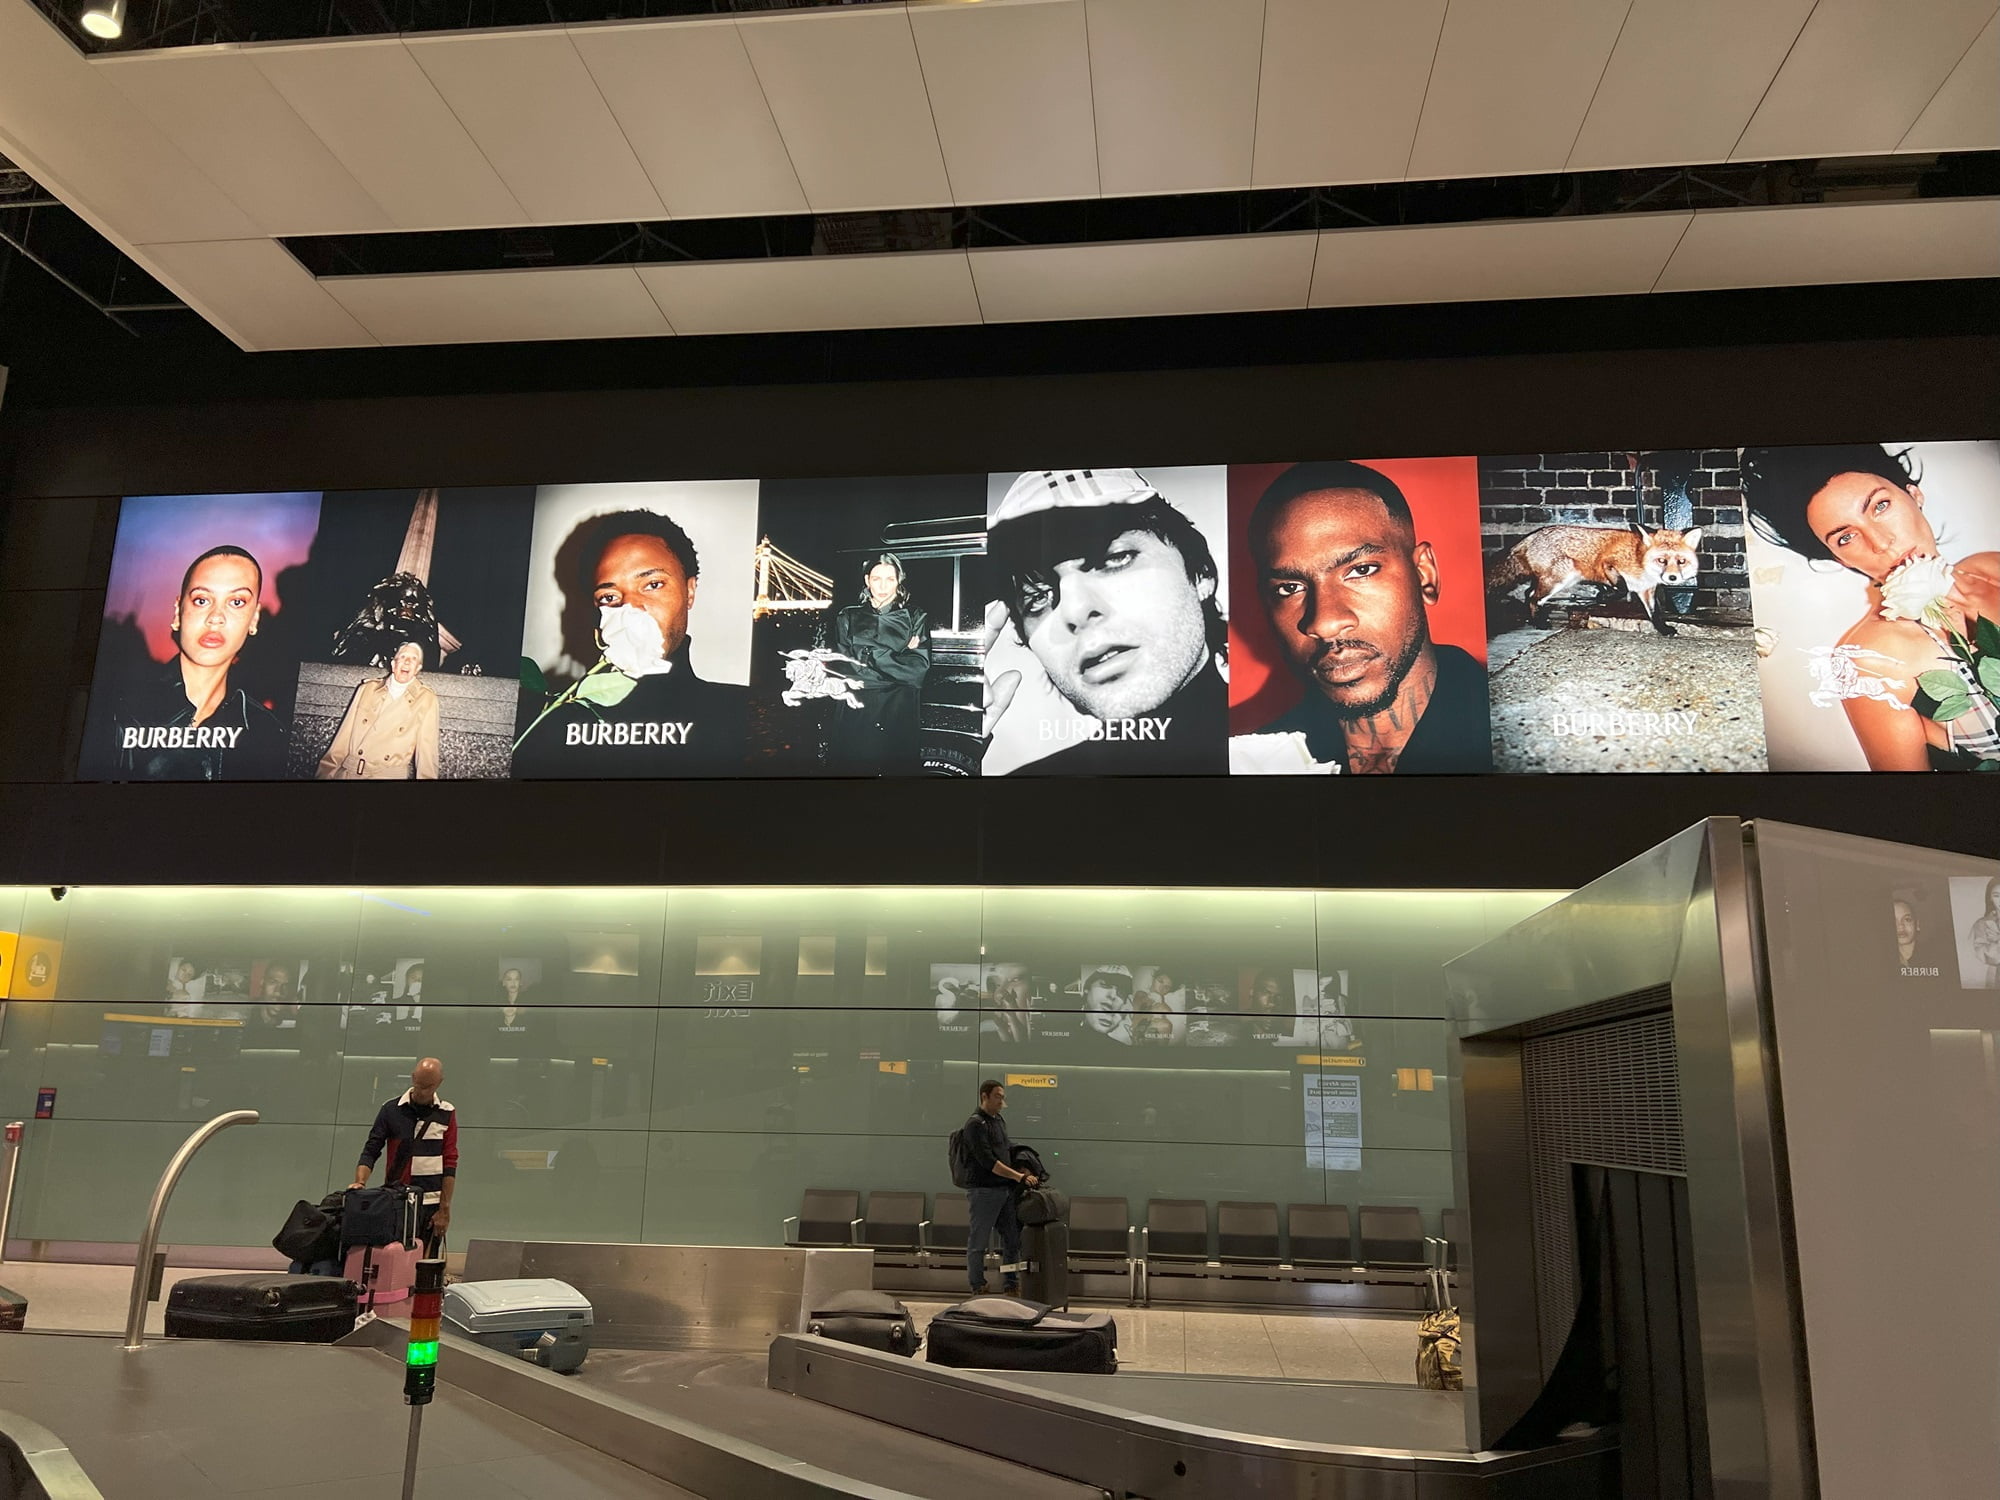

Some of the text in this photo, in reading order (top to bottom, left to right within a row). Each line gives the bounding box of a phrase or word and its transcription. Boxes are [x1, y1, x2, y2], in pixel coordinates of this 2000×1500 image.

[565, 722, 694, 745] BURBERRY
[1038, 717, 1173, 741] BURBERRY
[1552, 711, 1699, 737] BURBERRY
[122, 726, 243, 748] BURBERRY
